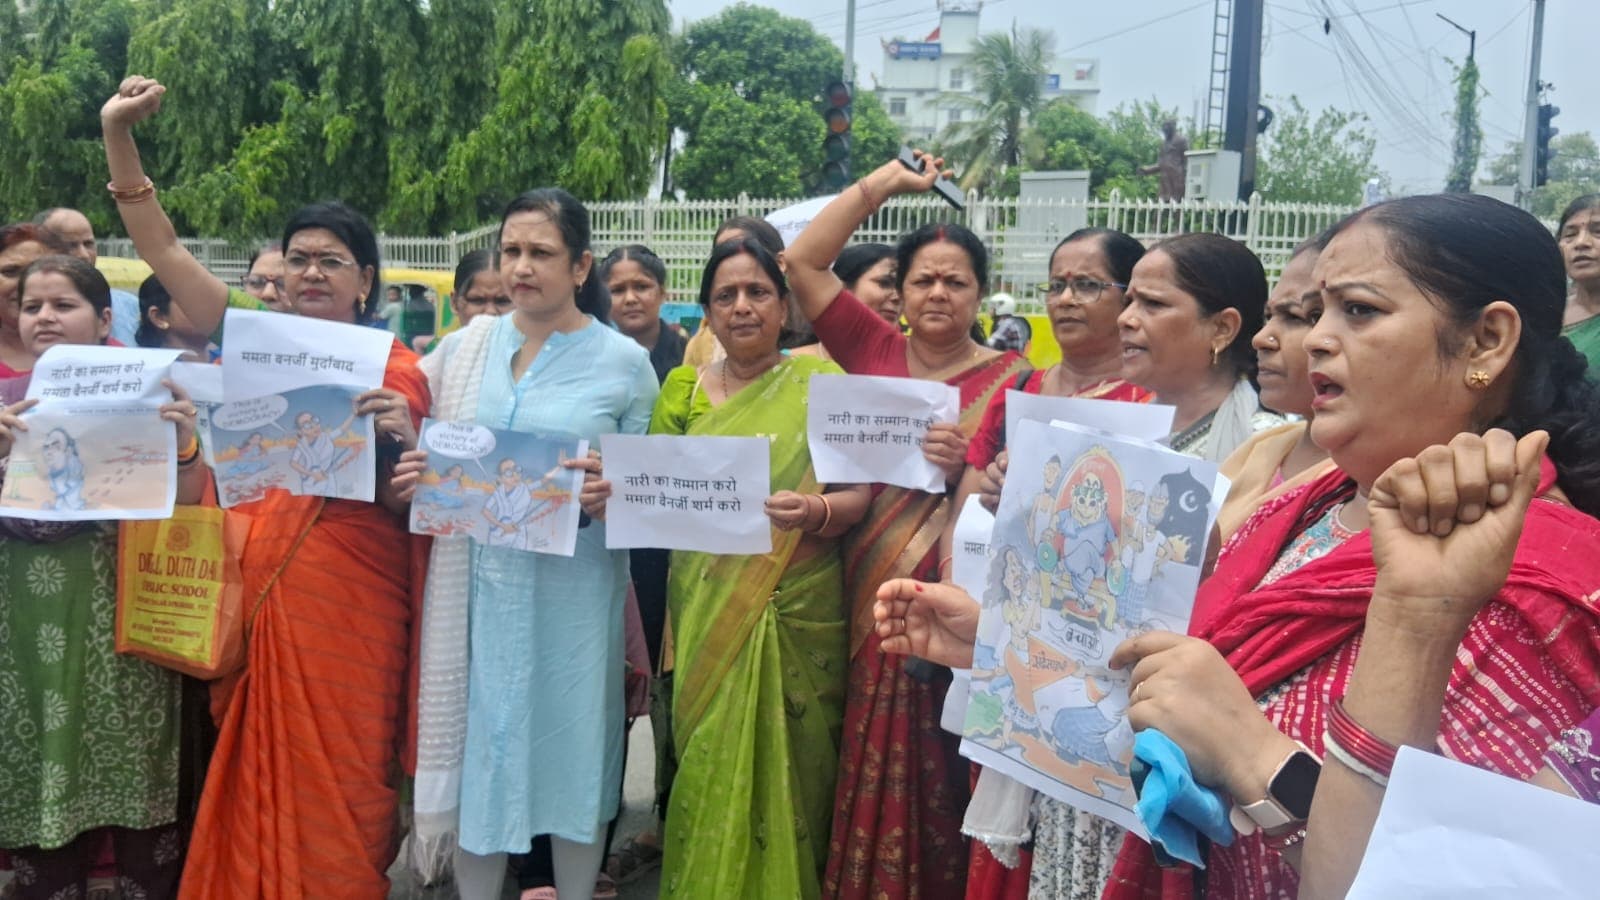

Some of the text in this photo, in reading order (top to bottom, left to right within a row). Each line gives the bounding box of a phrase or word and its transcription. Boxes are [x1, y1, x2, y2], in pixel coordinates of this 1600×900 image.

[241, 351, 271, 364] ममता
[275, 351, 309, 366] बनर्जी
[51, 360, 145, 380] नारी का सम्मान करो
[42, 386, 70, 398] ममता
[102, 380, 121, 394] शर्म
[121, 378, 143, 393] करो
[827, 411, 851, 425] नारी
[854, 414, 870, 425] का
[873, 415, 910, 427] सम्मान
[824, 432, 854, 443] ममता
[892, 432, 911, 445] शर्म
[624, 473, 737, 492] नारी का सम्मान करो
[625, 493, 656, 505] ममता
[692, 496, 713, 511] शर्म
[717, 498, 741, 512] करो
[964, 541, 985, 555] ममता
